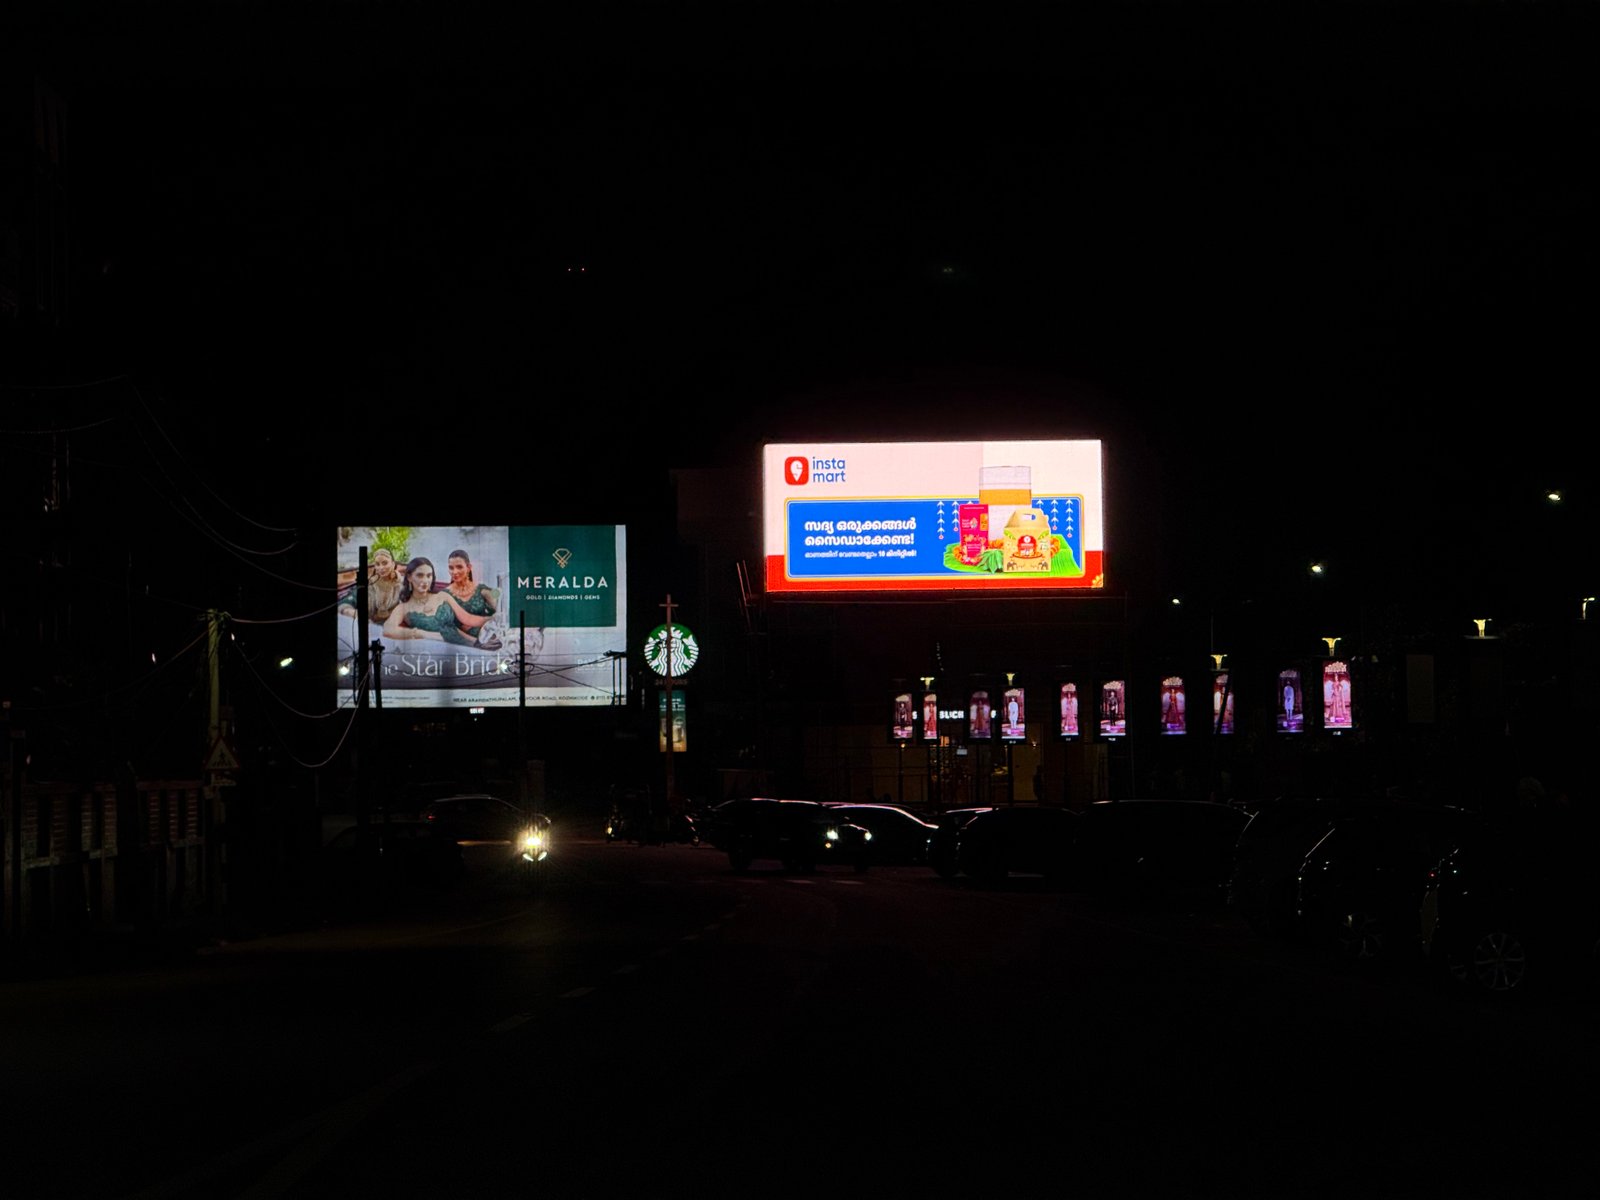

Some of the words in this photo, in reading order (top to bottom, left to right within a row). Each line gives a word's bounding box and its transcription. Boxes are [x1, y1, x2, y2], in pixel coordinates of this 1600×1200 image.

[812, 456, 846, 470] insta
[812, 470, 846, 483] mart
[804, 520, 834, 534] സദ്യ
[517, 576, 609, 588] MERALDA
[401, 651, 449, 677] Star
